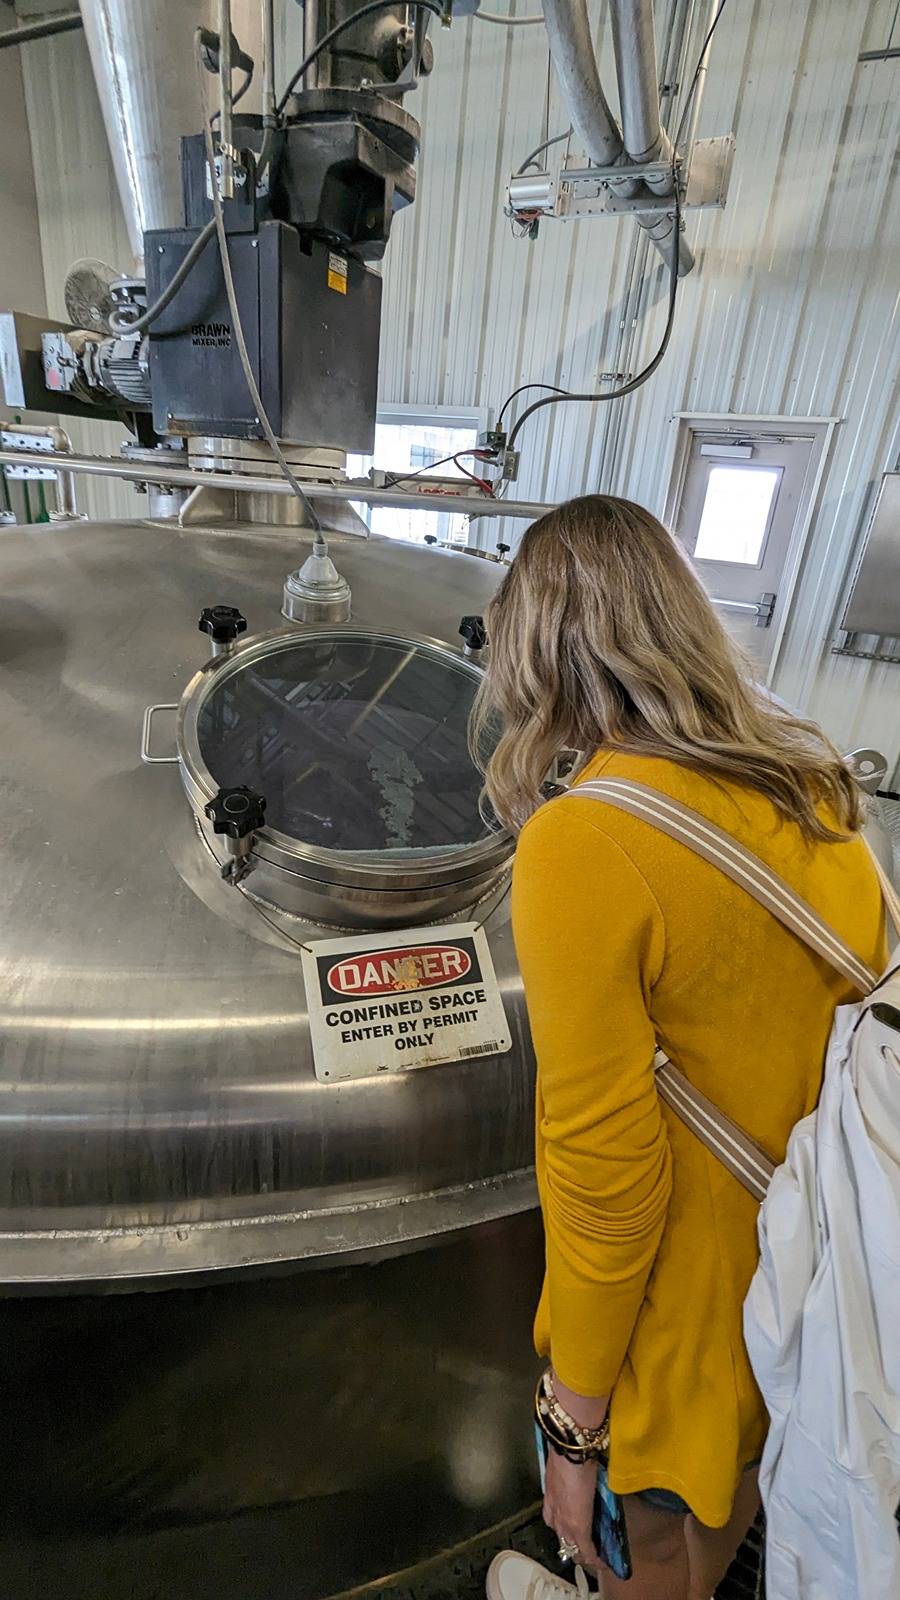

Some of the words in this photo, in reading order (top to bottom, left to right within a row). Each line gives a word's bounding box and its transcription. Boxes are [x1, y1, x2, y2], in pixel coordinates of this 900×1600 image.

[192, 323, 230, 336] BRAWN
[338, 951, 463, 990] DANGER
[325, 999, 423, 1027] CONFINED
[429, 989, 487, 1011] SPACE
[341, 1024, 394, 1043] ENTER
[399, 1019, 419, 1034] BY
[423, 1010, 479, 1030] PERMIT
[394, 1033, 435, 1050] ONLY
